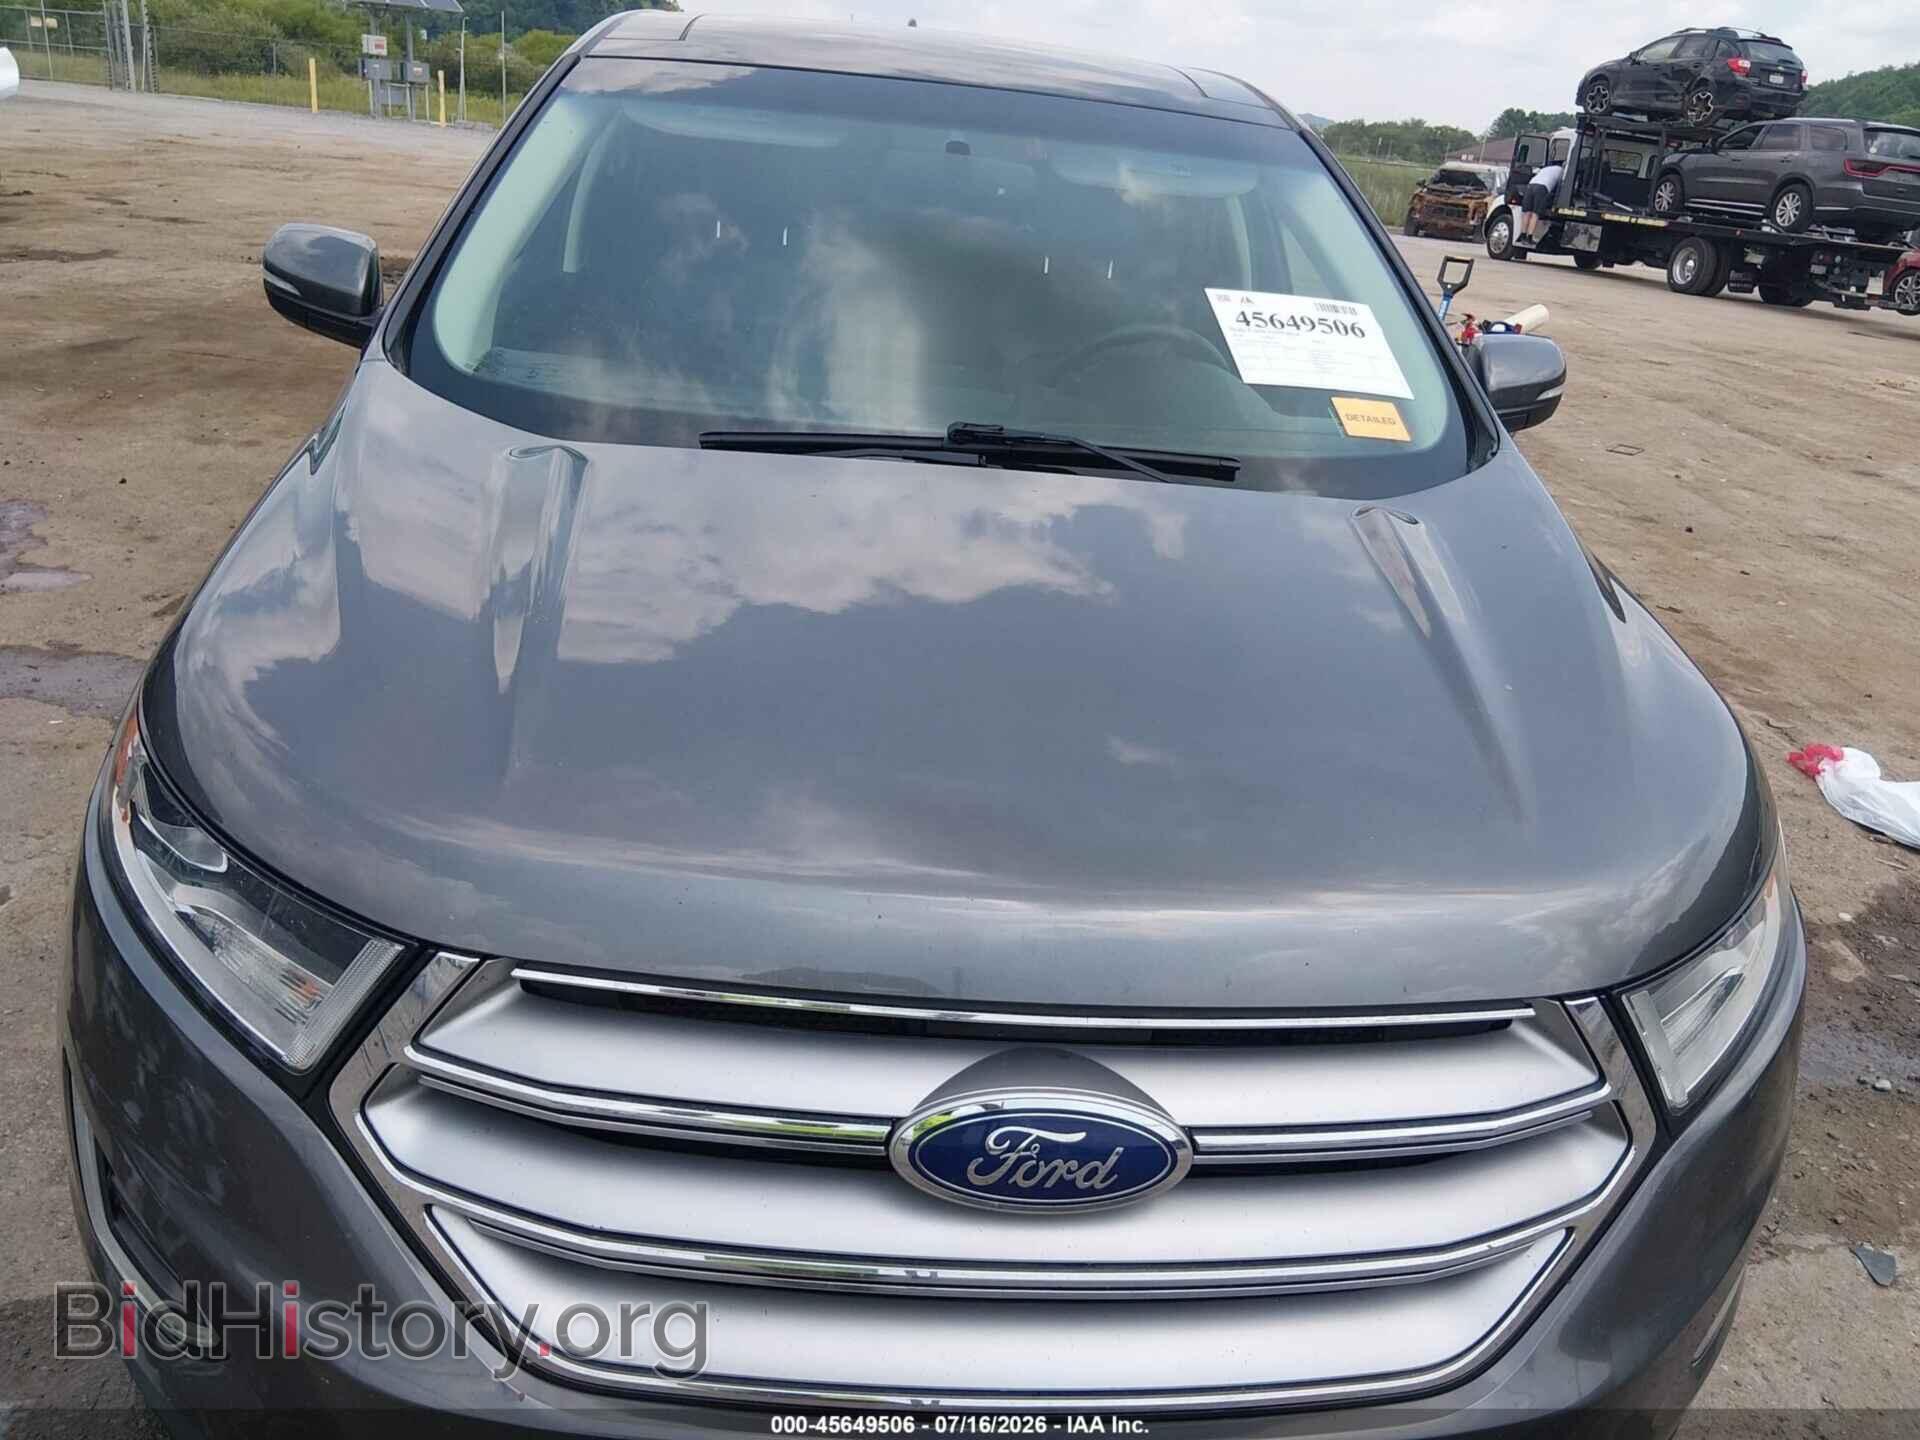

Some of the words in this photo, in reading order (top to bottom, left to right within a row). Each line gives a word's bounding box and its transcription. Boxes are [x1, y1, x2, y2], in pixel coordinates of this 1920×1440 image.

[1235, 309, 1366, 339] 45649506
[1345, 413, 1397, 426] DETAILED
[966, 1126, 1124, 1189] Ford
